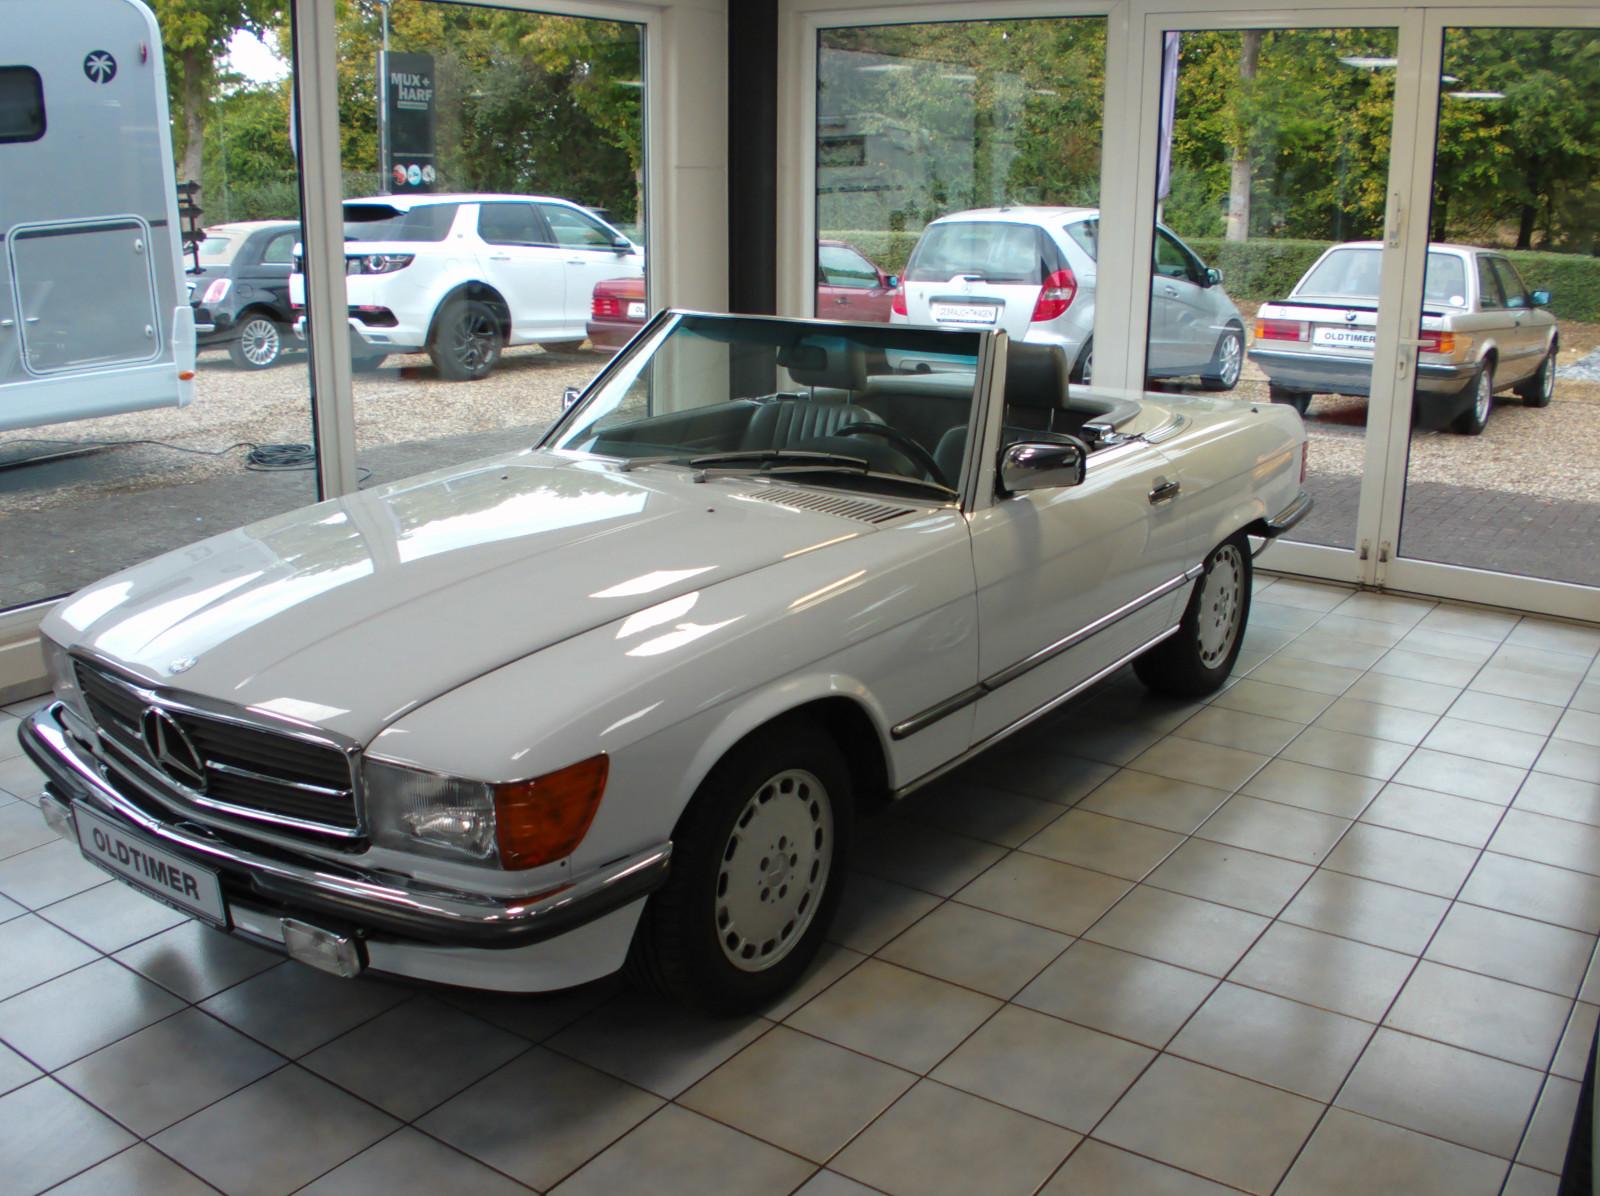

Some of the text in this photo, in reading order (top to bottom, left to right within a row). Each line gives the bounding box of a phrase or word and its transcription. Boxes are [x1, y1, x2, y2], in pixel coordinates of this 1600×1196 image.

[399, 87, 433, 101] HARF
[1324, 332, 1376, 343] OLDTIMER
[93, 827, 200, 900] OLDTIMER
